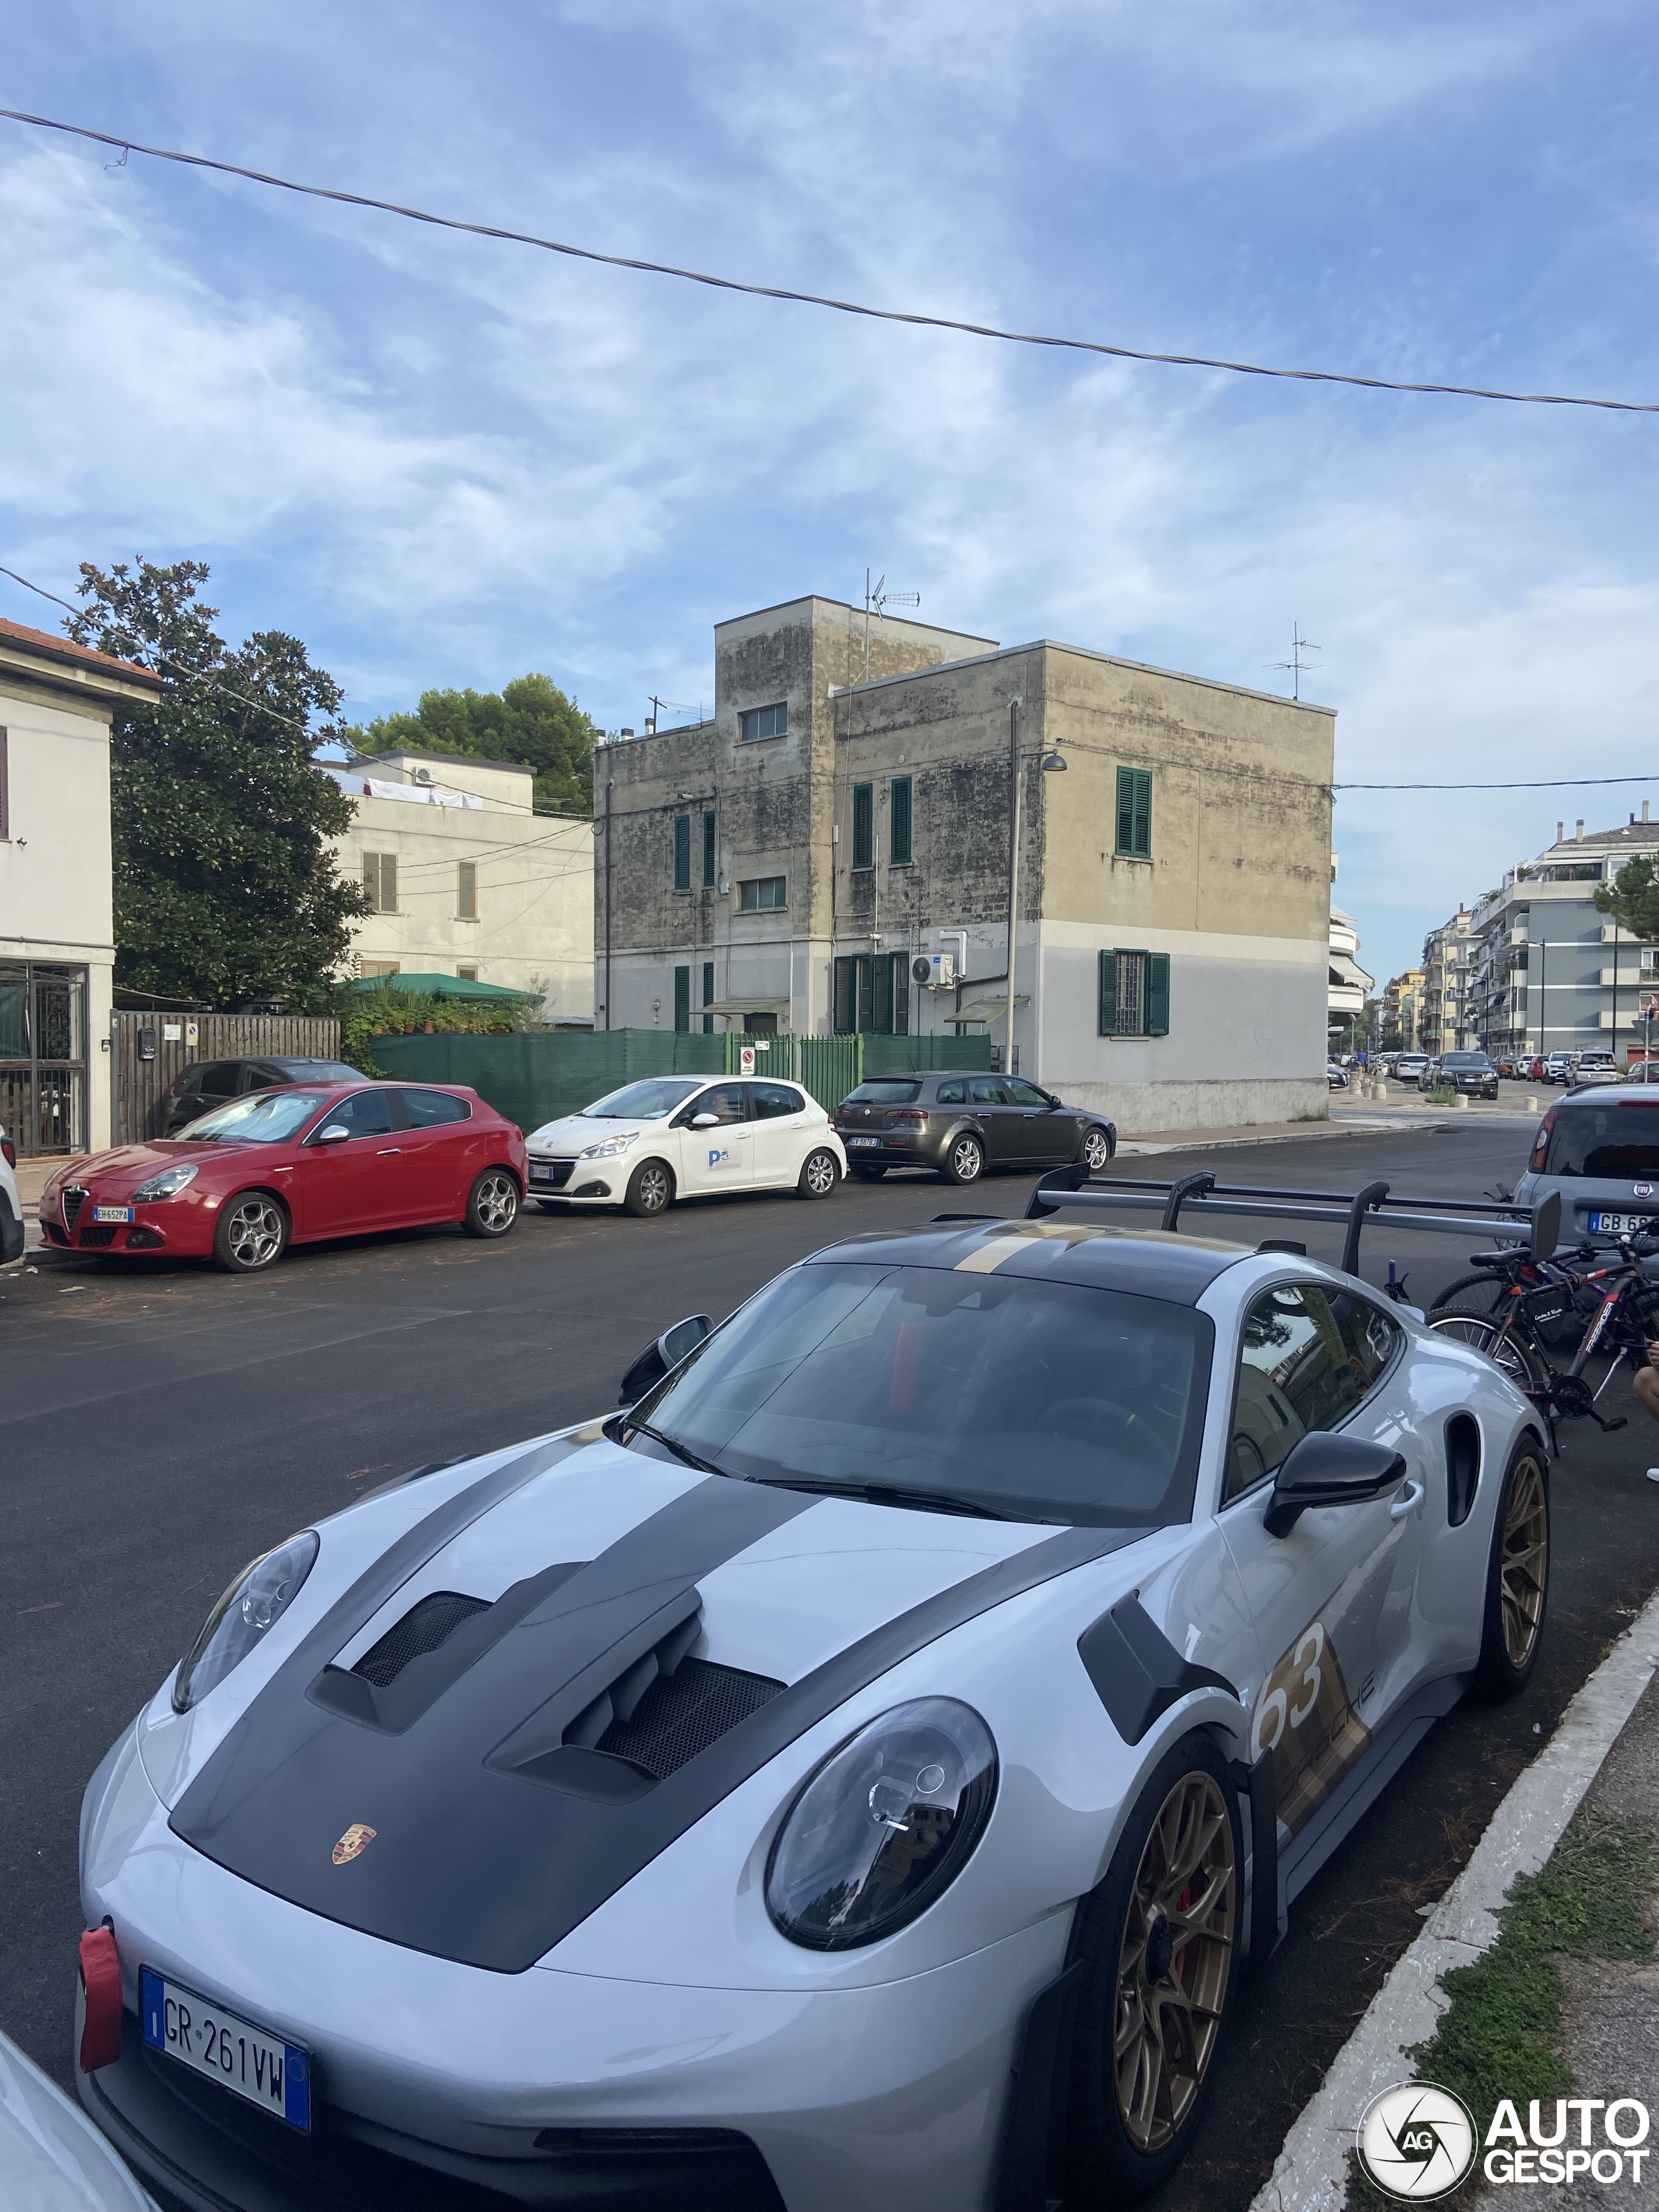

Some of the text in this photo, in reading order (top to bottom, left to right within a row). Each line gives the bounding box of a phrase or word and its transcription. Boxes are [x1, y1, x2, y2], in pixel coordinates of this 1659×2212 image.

[1601, 1215, 1621, 1231] GB
[1250, 1622, 1323, 1764] 63
[164, 1997, 192, 2053] GR
[203, 2019, 283, 2103] 261VW
